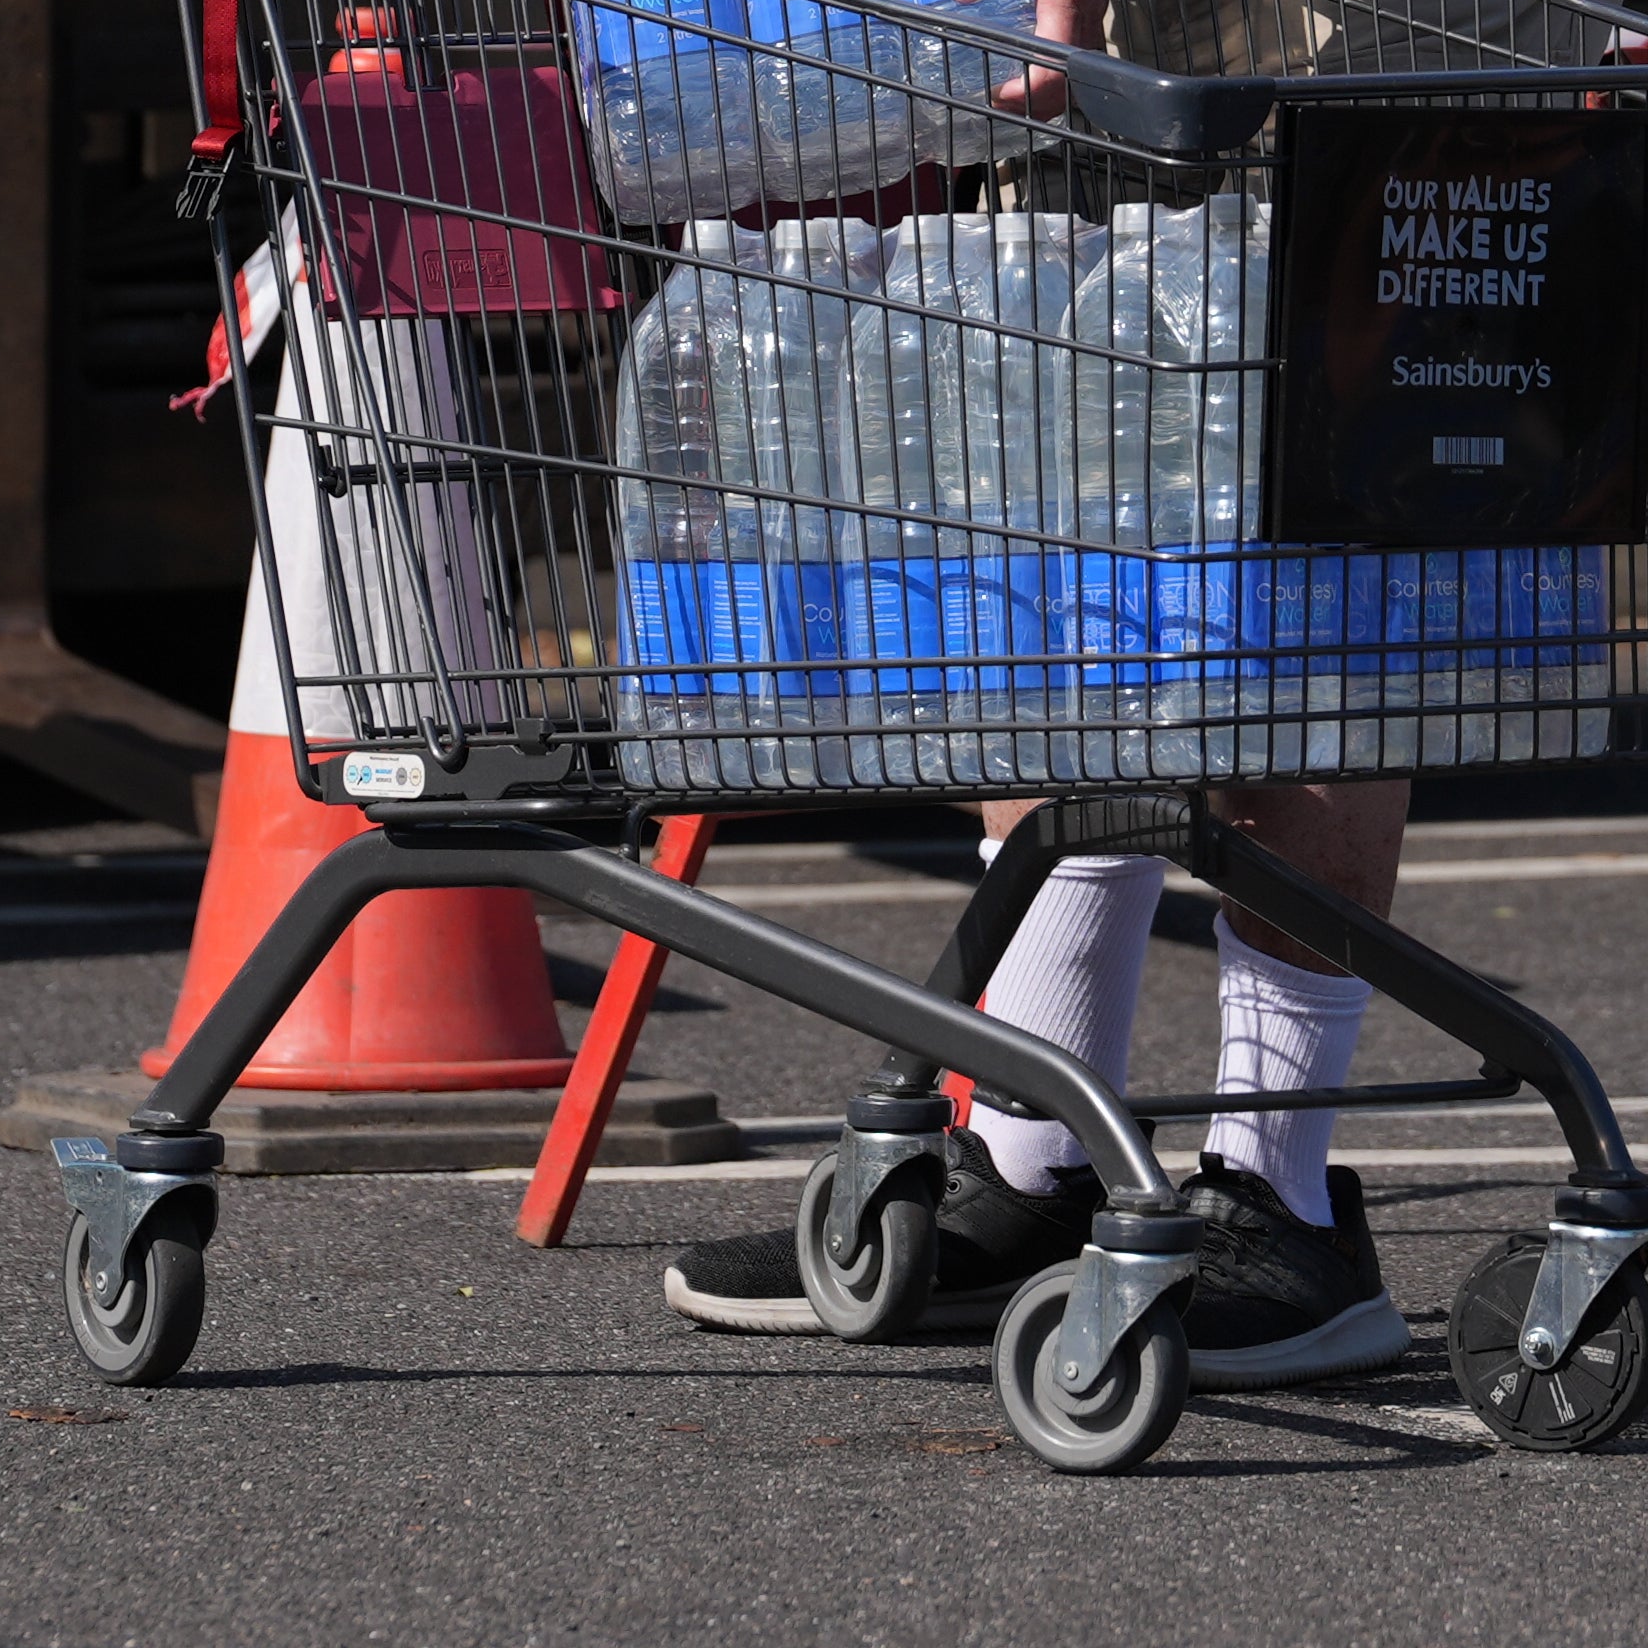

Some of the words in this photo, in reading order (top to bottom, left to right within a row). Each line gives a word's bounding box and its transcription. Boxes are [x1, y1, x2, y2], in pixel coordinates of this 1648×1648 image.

[1384, 178, 1439, 210] OUR
[1446, 174, 1551, 214] VALUES
[1381, 212, 1491, 261] MAKE
[1504, 223, 1549, 264] US
[1377, 263, 1546, 307] DIFFERENT
[1392, 355, 1552, 395] Sainsbury's
[1256, 582, 1337, 604] Couresy
[1539, 594, 1592, 613] Waer
[1275, 606, 1329, 625] Waer
